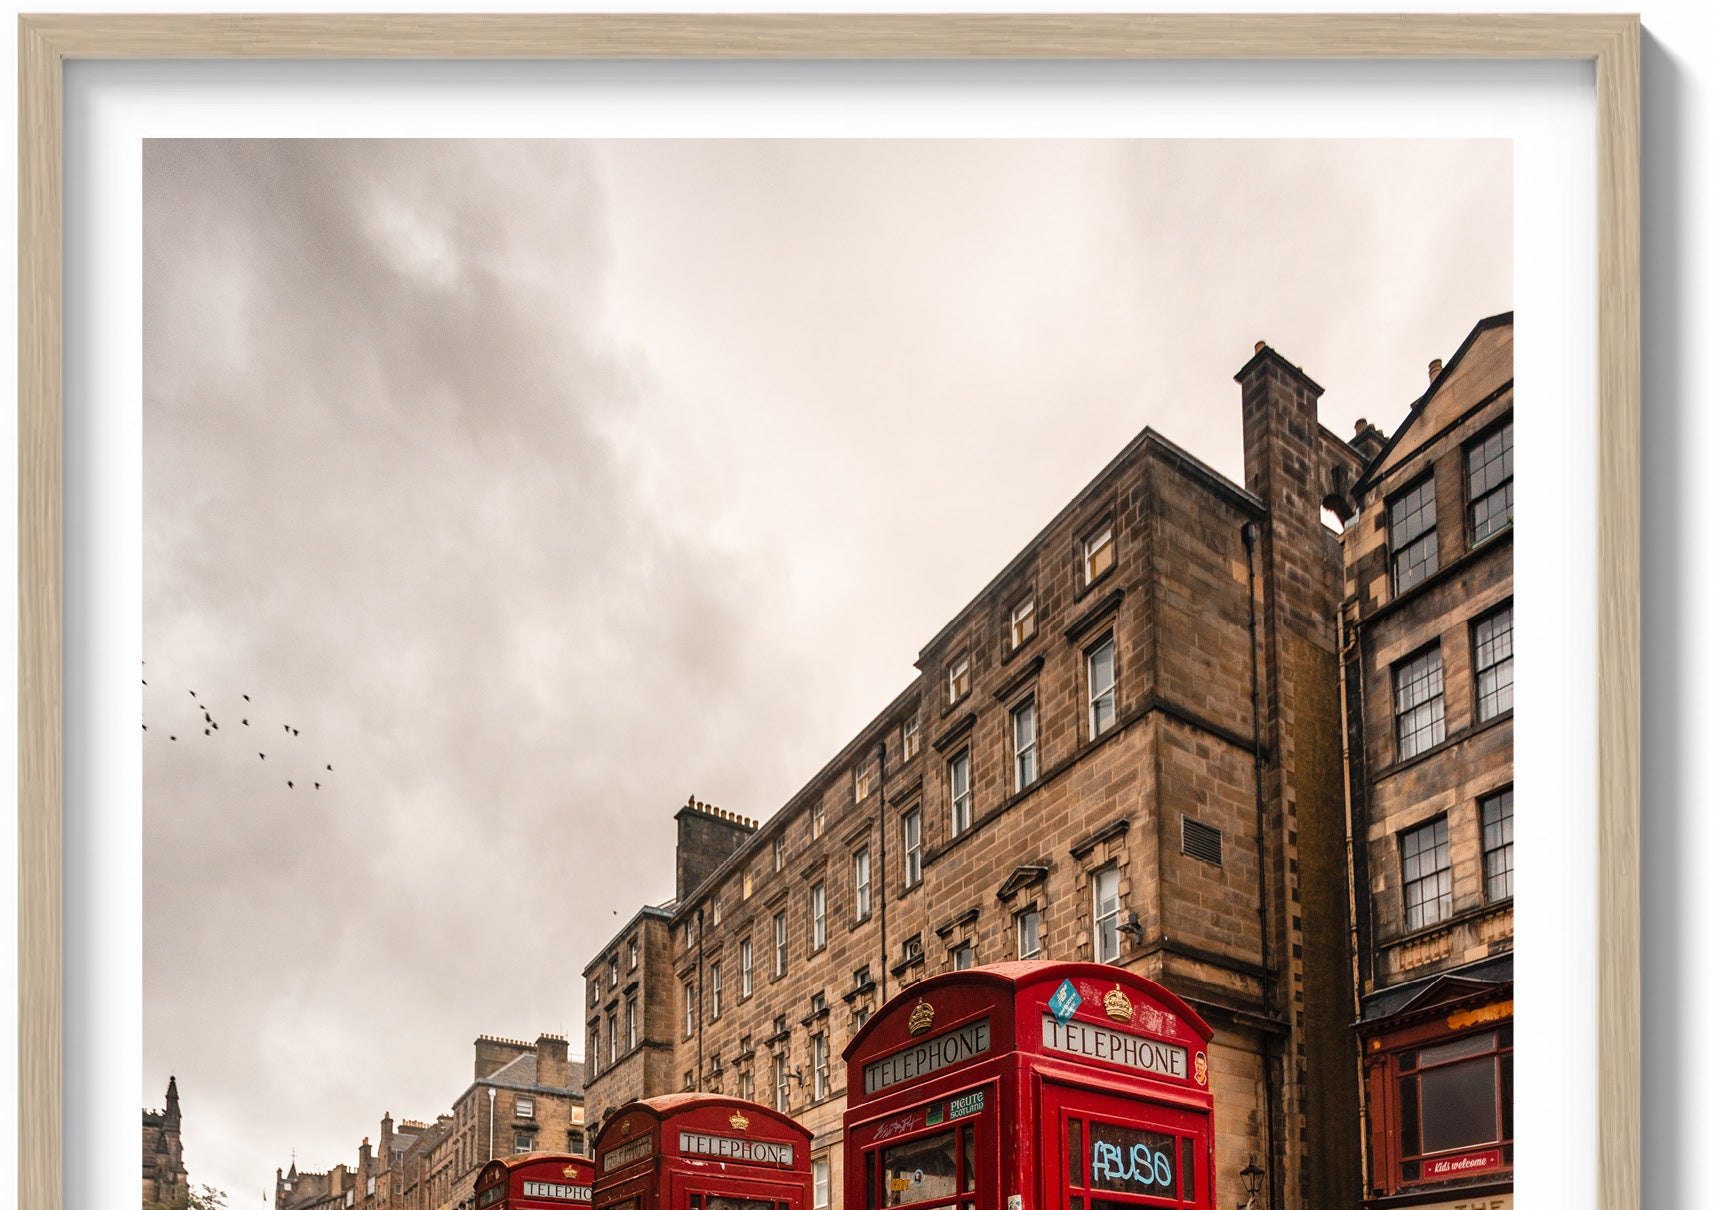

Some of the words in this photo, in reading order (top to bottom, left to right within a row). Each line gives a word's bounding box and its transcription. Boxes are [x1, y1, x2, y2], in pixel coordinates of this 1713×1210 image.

[867, 1023, 987, 1092] TELEPHONE
[1047, 1019, 1181, 1076] TELEPHONE
[682, 1134, 790, 1165] TELEPHONE
[1434, 1163, 1450, 1173] Kids
[1451, 1157, 1487, 1171] welcome
